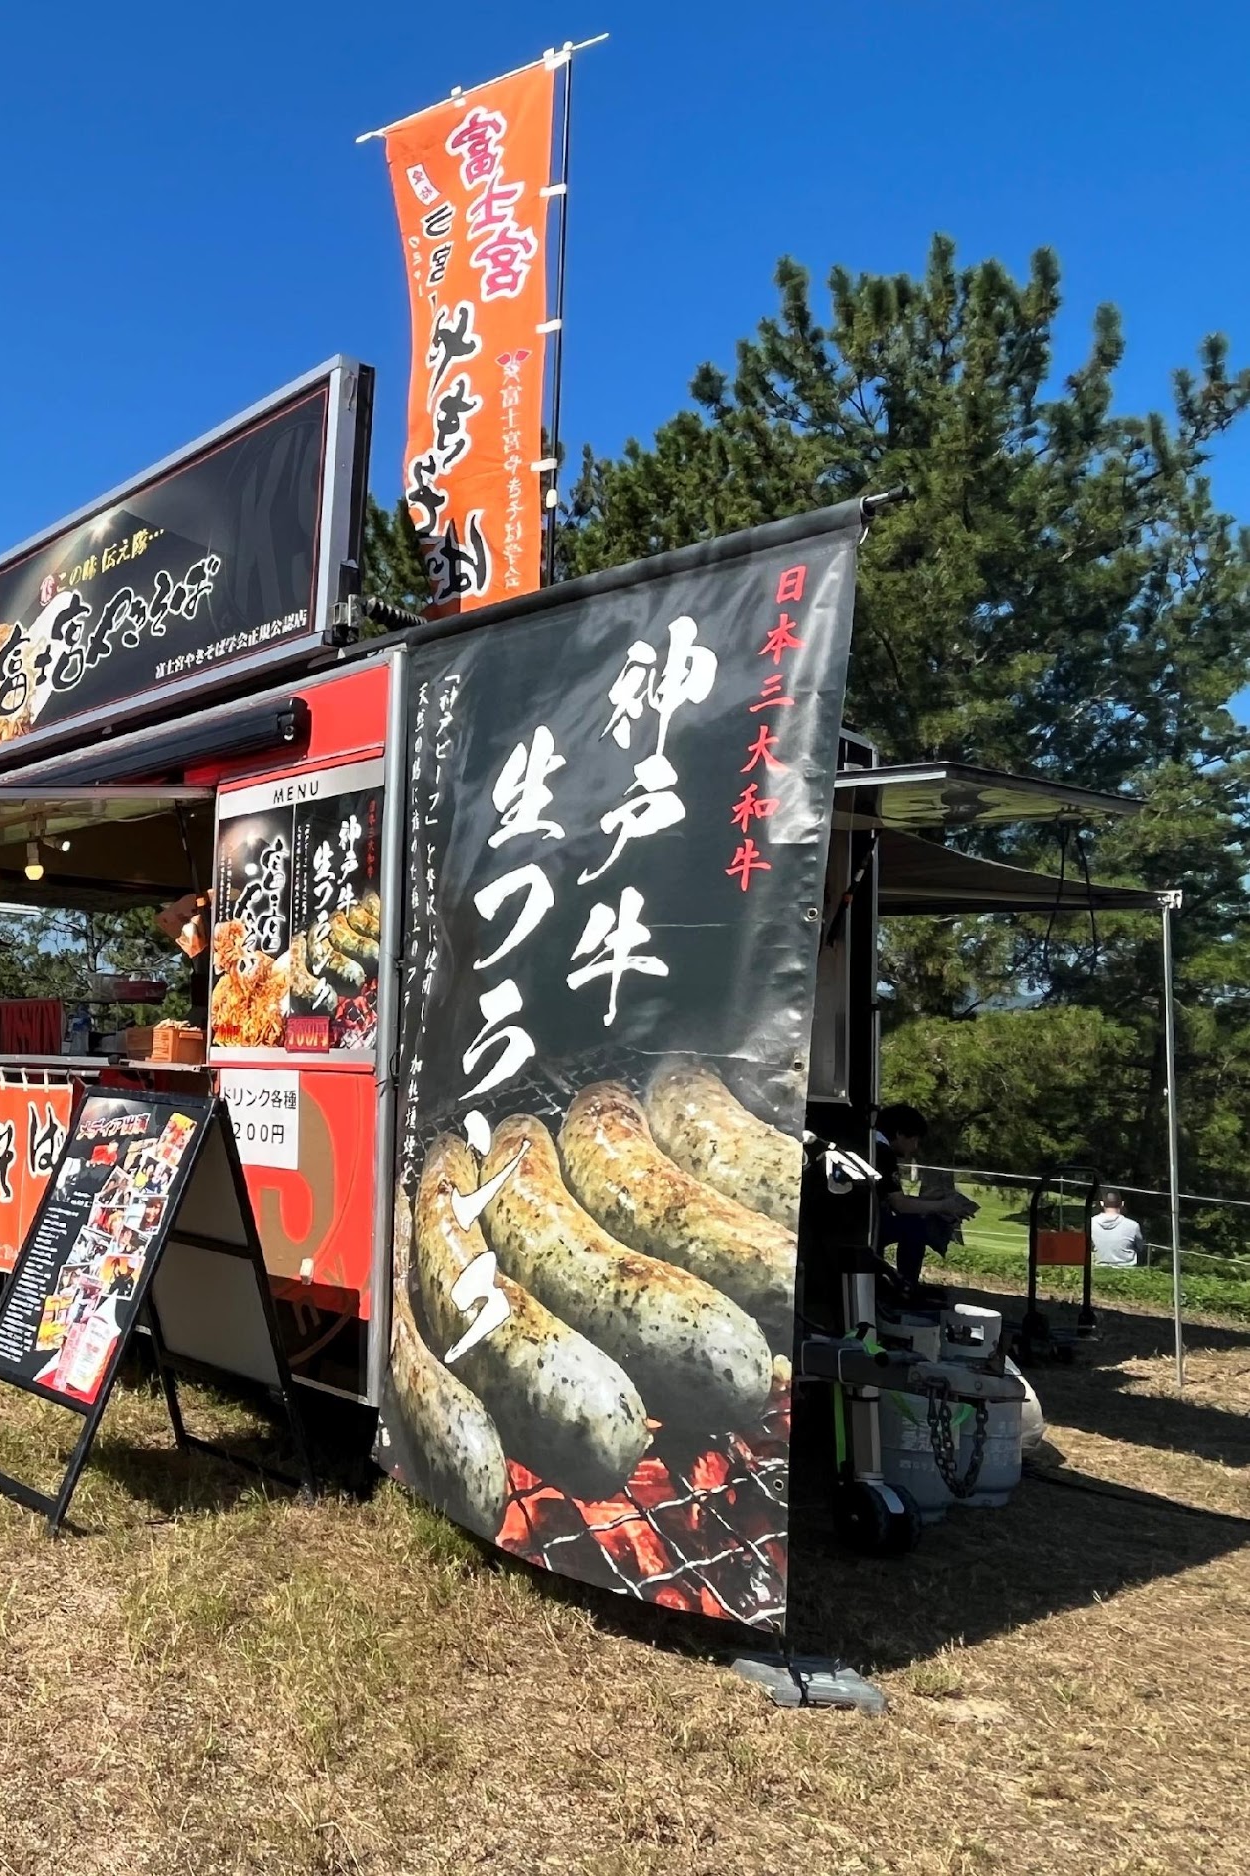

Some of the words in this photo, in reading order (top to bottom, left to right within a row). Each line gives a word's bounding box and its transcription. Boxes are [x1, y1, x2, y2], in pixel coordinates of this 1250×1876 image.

[448, 108, 536, 300] 富士宮
[407, 304, 491, 599] やきそば
[273, 780, 319, 804] MENU
[725, 565, 806, 892] 日本三大和牛
[337, 814, 362, 918] 神戸牛
[567, 616, 718, 1026] 神戸牛
[312, 840, 336, 1010] 生フランク
[223, 1086, 297, 1110] ドリンク各種
[234, 1122, 285, 1144] 200円
[444, 725, 565, 1362] 生フランク
